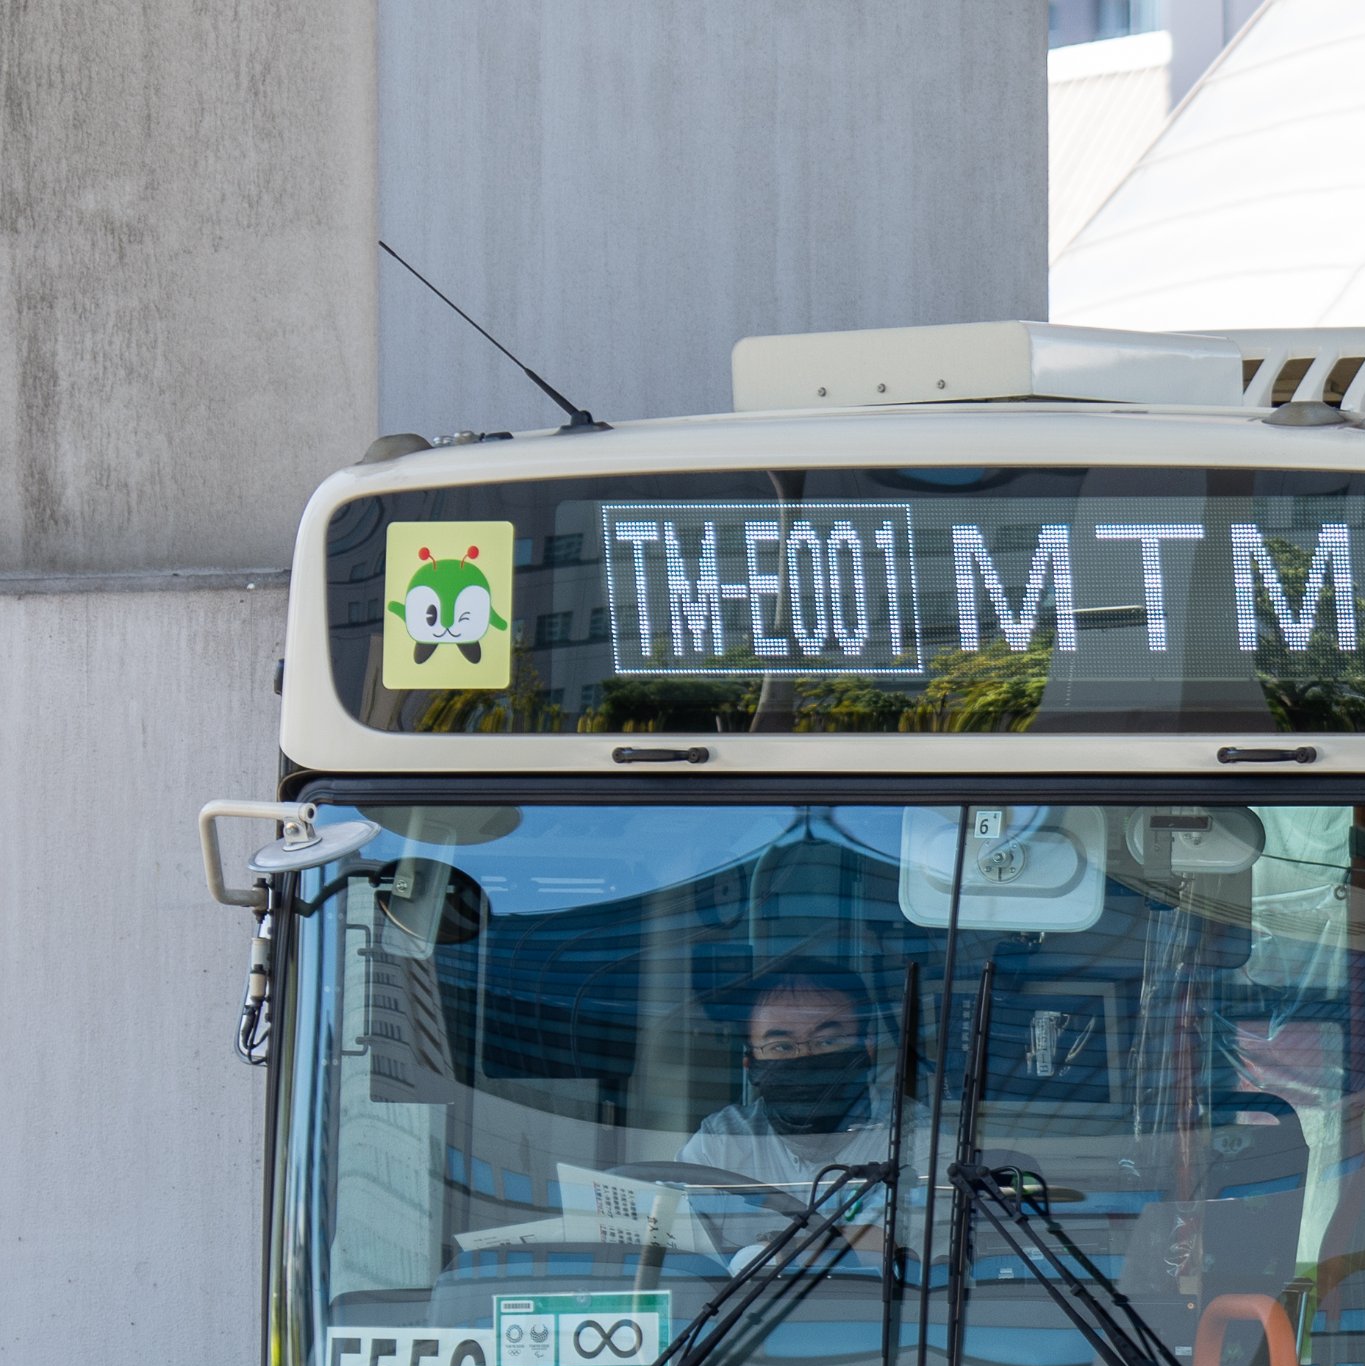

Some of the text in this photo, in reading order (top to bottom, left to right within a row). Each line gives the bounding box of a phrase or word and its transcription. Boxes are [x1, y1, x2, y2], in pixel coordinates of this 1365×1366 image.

[615, 520, 1357, 657] TM-E001 MTM
[979, 818, 989, 835] 6
